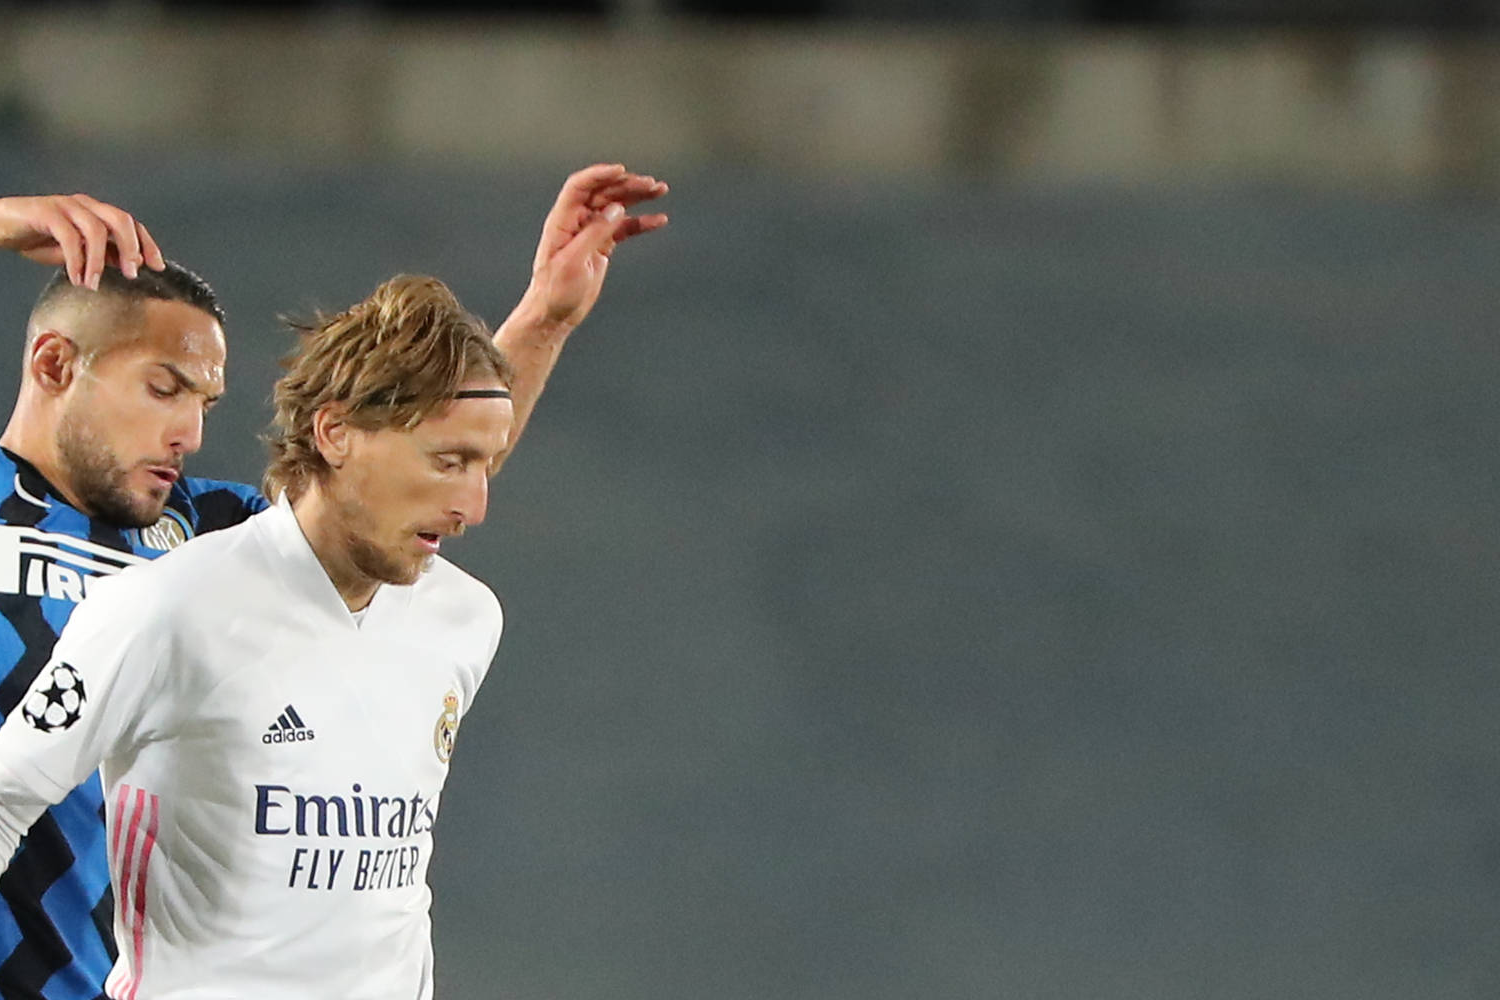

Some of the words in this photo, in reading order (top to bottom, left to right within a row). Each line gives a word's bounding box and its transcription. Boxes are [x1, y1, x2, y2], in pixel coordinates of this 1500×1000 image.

[262, 728, 315, 744] adidas
[288, 848, 344, 890] FLY
[353, 846, 420, 891] BETTER
